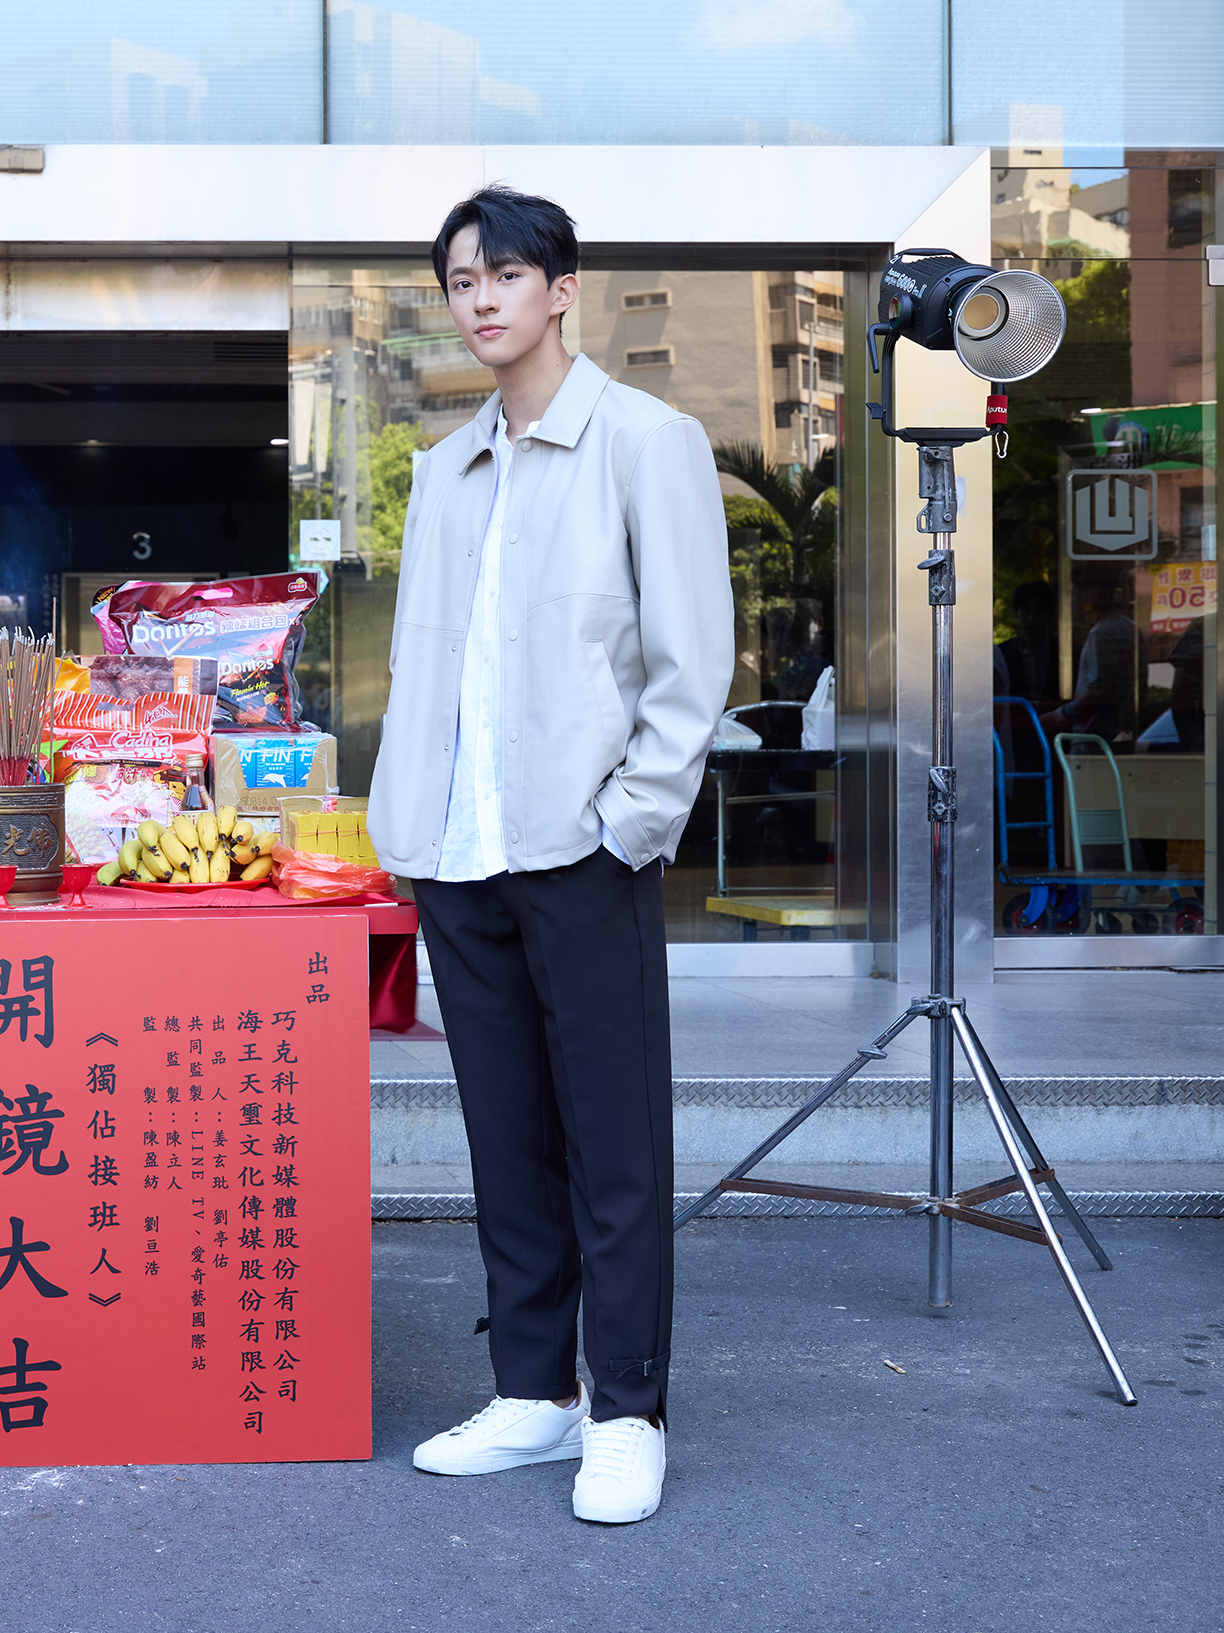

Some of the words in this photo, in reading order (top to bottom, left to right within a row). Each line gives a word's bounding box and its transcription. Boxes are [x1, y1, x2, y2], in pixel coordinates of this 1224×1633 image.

[132, 532, 152, 561] 3
[132, 621, 216, 643] Doritos
[220, 658, 274, 677] Doritos
[112, 731, 170, 748] Cadina
[306, 952, 330, 1004] 出品
[237, 1010, 267, 1434] 海王天璽文化傳媒股份有限公司
[271, 1010, 300, 1402] 巧克科技新媒體股份有限公司
[213, 1209, 229, 1268] 劉亭佑
